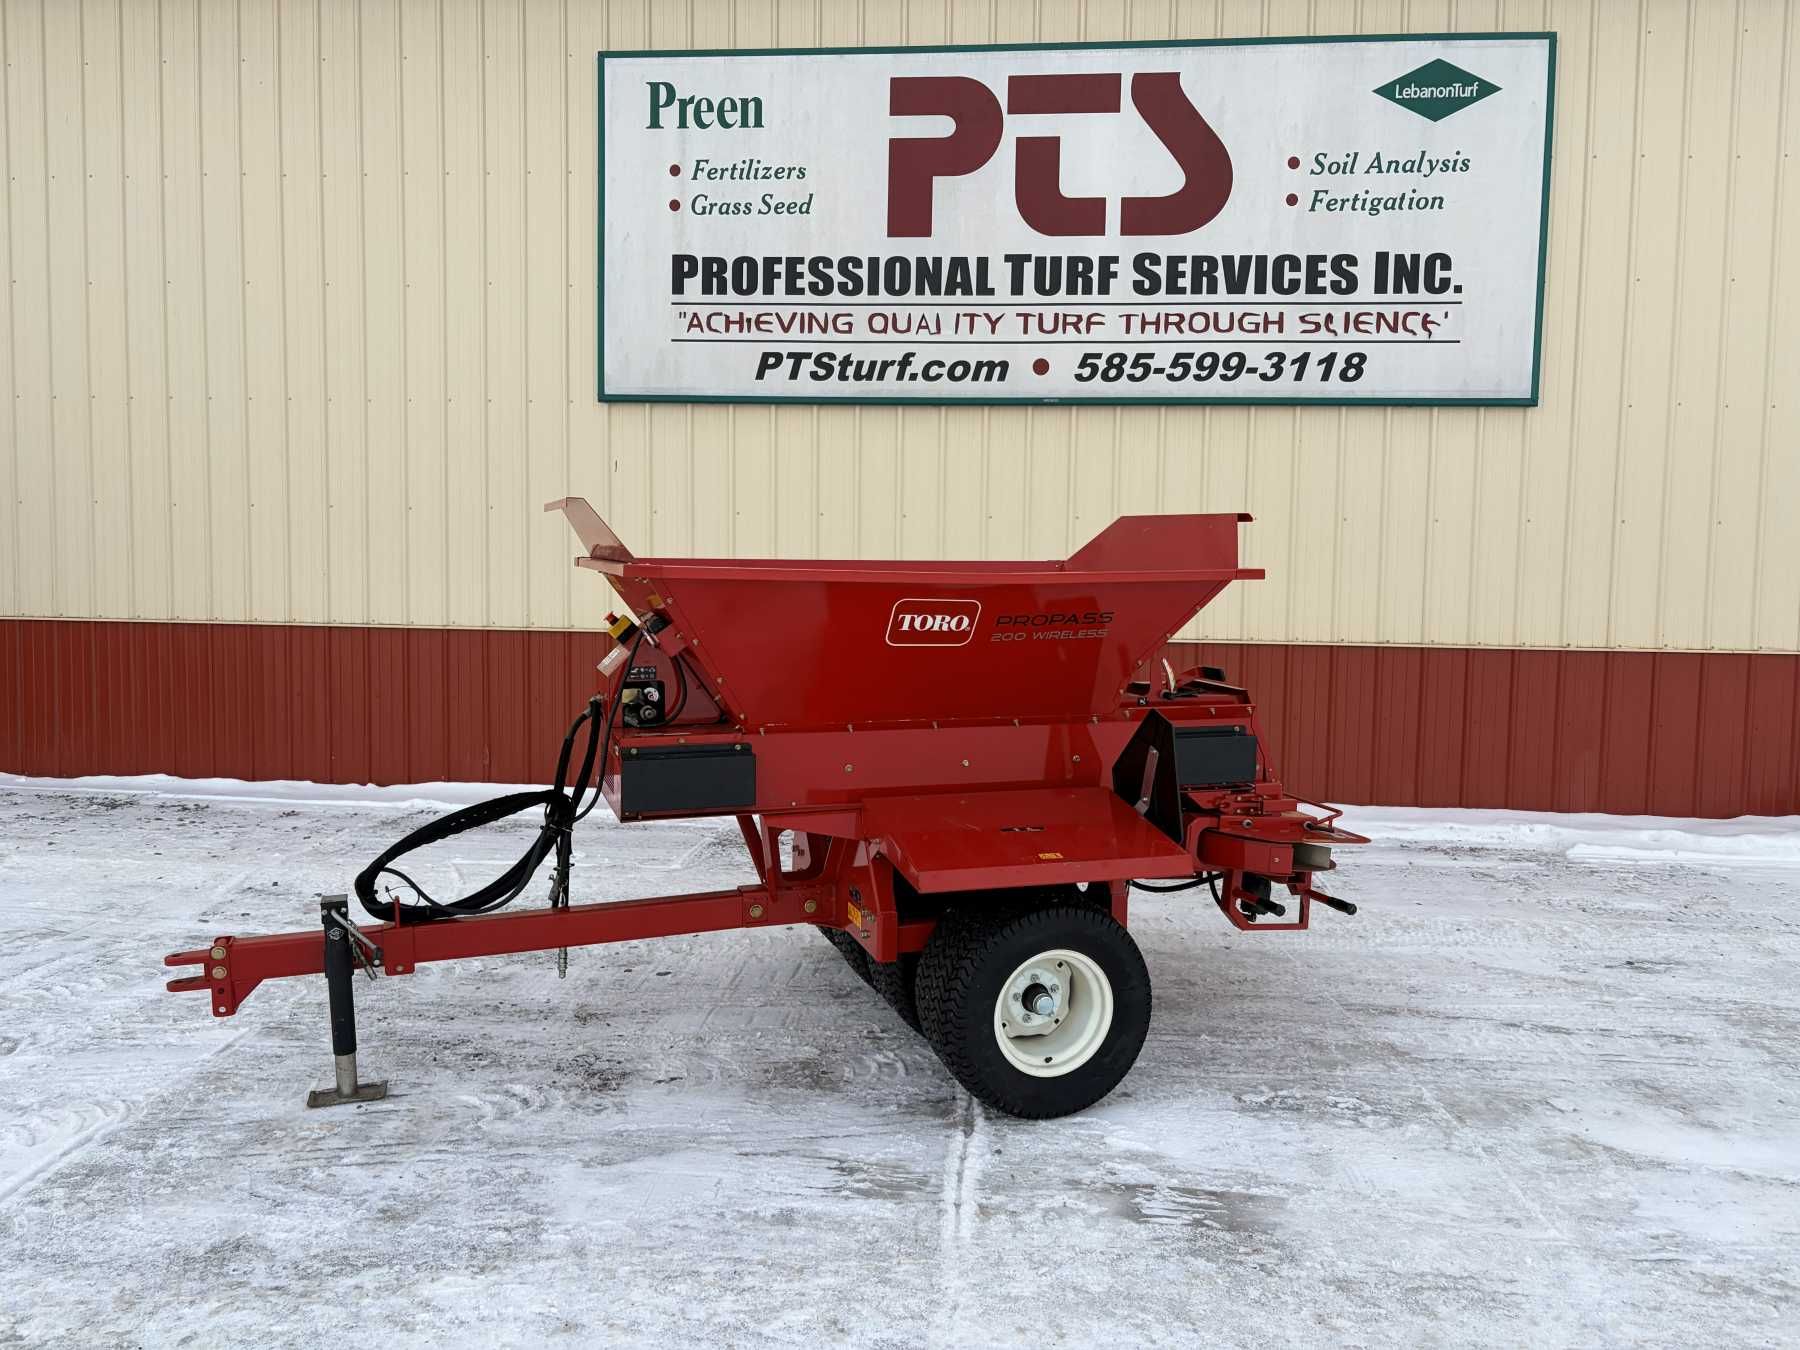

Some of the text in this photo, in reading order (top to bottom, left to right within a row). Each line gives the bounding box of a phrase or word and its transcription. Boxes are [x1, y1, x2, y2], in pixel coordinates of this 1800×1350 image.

[1395, 82, 1479, 99] LebanonTurf
[646, 82, 765, 130] Preen
[886, 72, 1234, 238] PTS
[1309, 151, 1471, 178] Soil Analysis
[690, 159, 807, 181] Fertilizers
[691, 193, 814, 216] Grass Seed
[1308, 189, 1444, 217] Fertigation
[672, 251, 1463, 297] PROFESSIONAL TURF SERVICES INC.
[1015, 312, 1106, 335] TURF
[1118, 312, 1284, 335] THROUGH
[754, 351, 1010, 382] PTSturf.com
[1073, 351, 1368, 383] 585-599-3118
[898, 614, 970, 632] TORO
[995, 611, 1115, 627] PROPASS
[991, 629, 1109, 642] 200 WIRELESS
